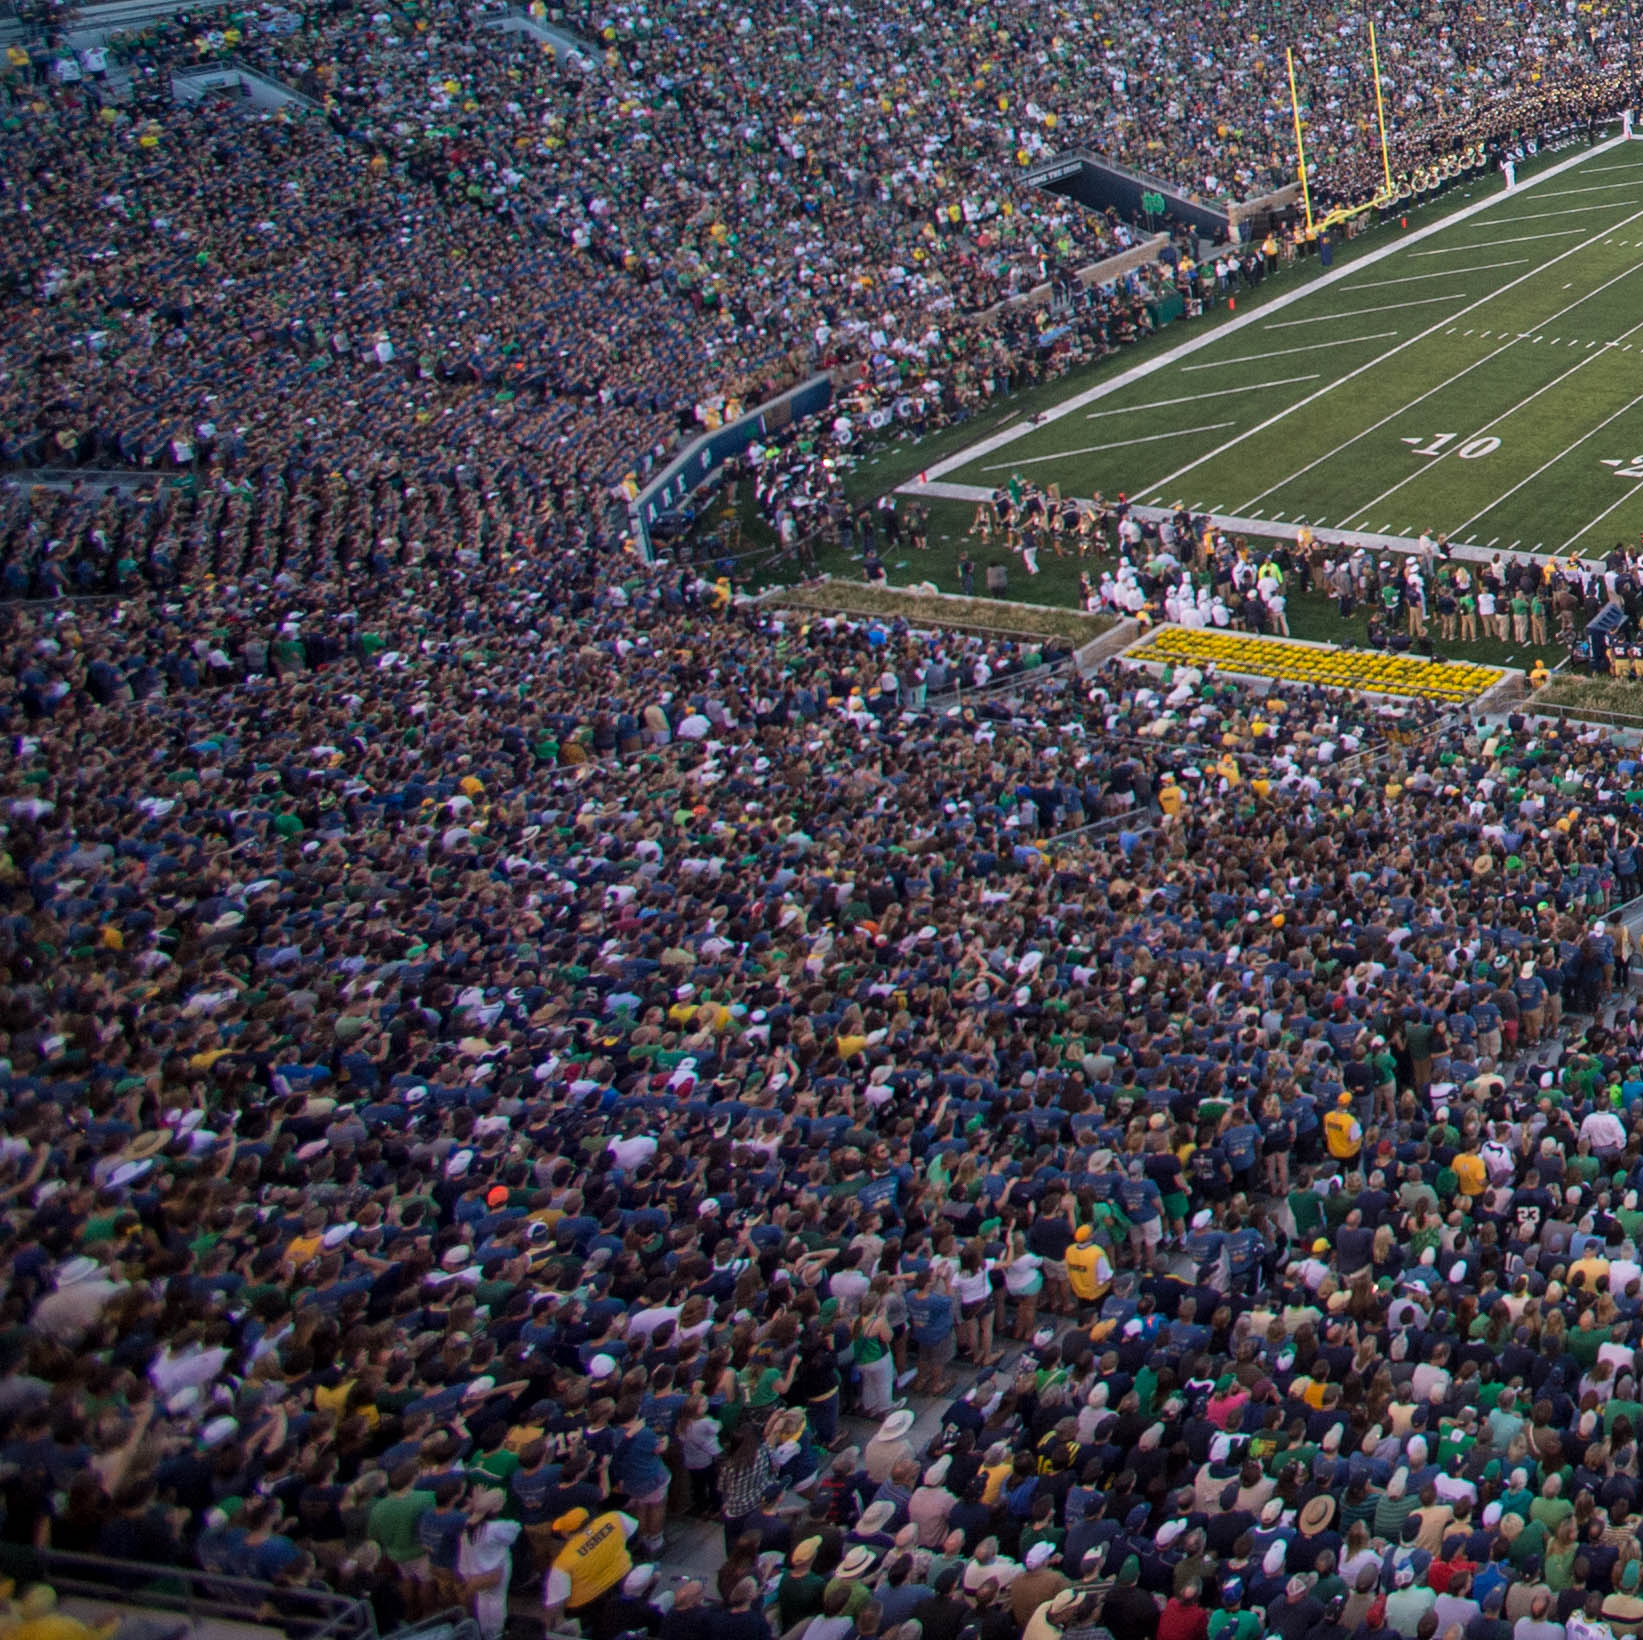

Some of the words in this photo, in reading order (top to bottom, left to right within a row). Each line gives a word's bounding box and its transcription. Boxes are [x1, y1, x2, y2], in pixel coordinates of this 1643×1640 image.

[1411, 432, 1502, 461] 10
[1517, 1206, 1540, 1224] 23
[577, 1522, 615, 1558] USHER
